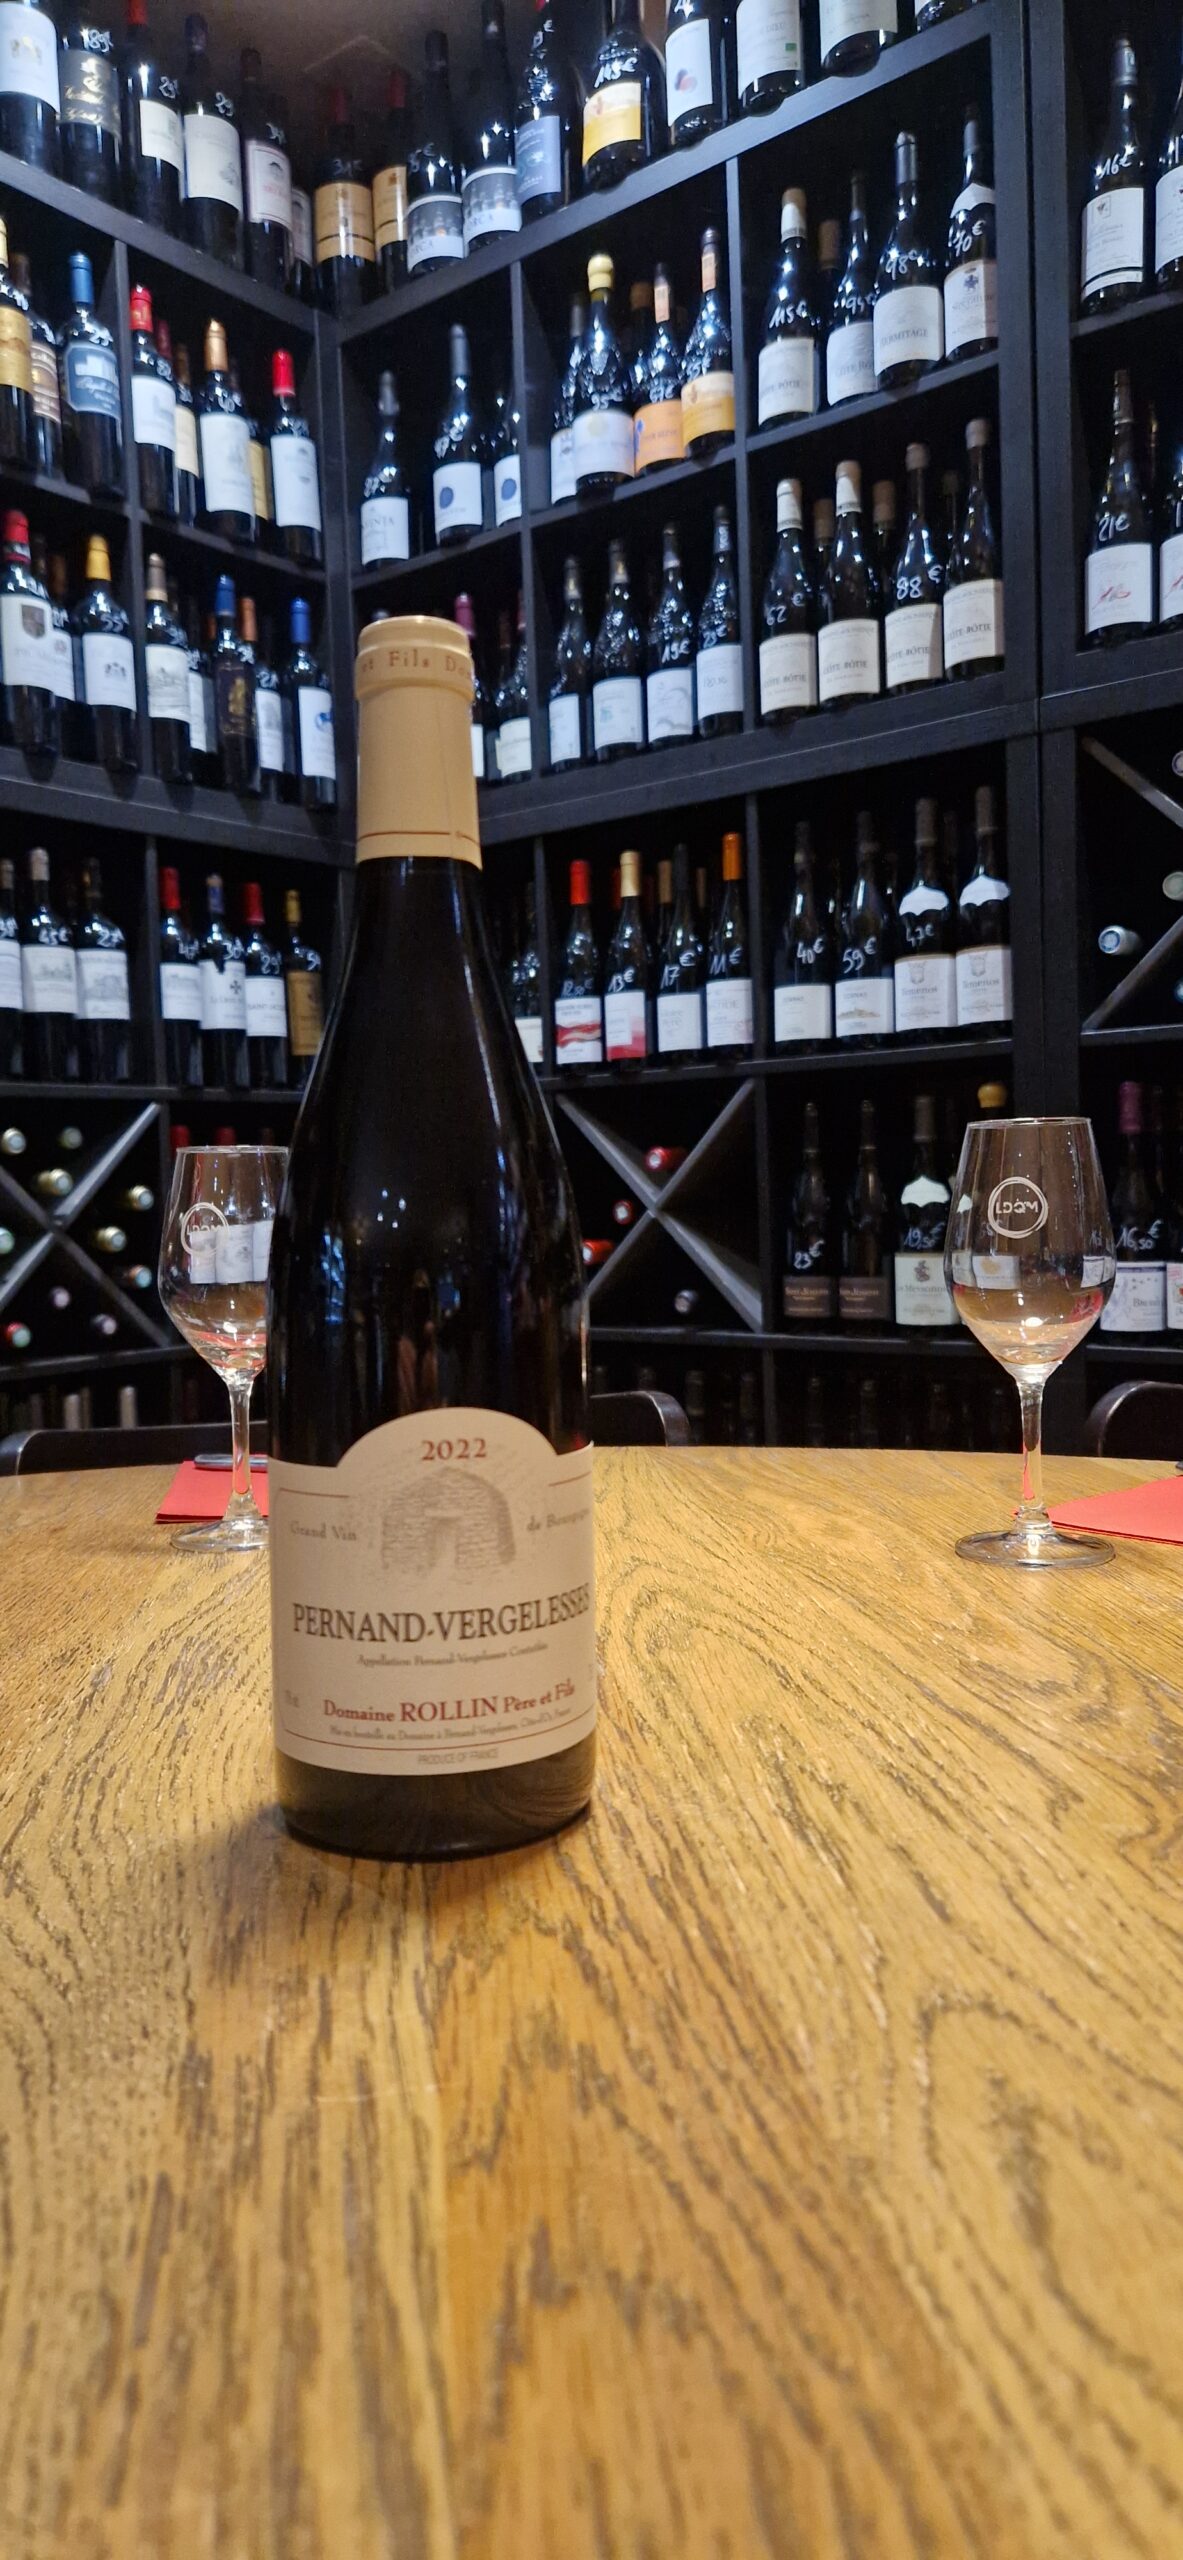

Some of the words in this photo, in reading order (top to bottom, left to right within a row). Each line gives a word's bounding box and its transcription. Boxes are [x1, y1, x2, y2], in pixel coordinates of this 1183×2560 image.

[389, 648, 430, 668] Fils
[421, 1437, 488, 1462] 2022
[290, 1519, 328, 1539] Grand
[331, 1525, 358, 1541] Vin
[527, 1514, 541, 1532] de
[292, 1582, 590, 1643] PERNAND-VERGELESSES
[323, 1699, 396, 1723] Domaine
[400, 1696, 499, 1723] ROLLIN
[503, 1694, 537, 1714] Père
[540, 1692, 553, 1706] et
